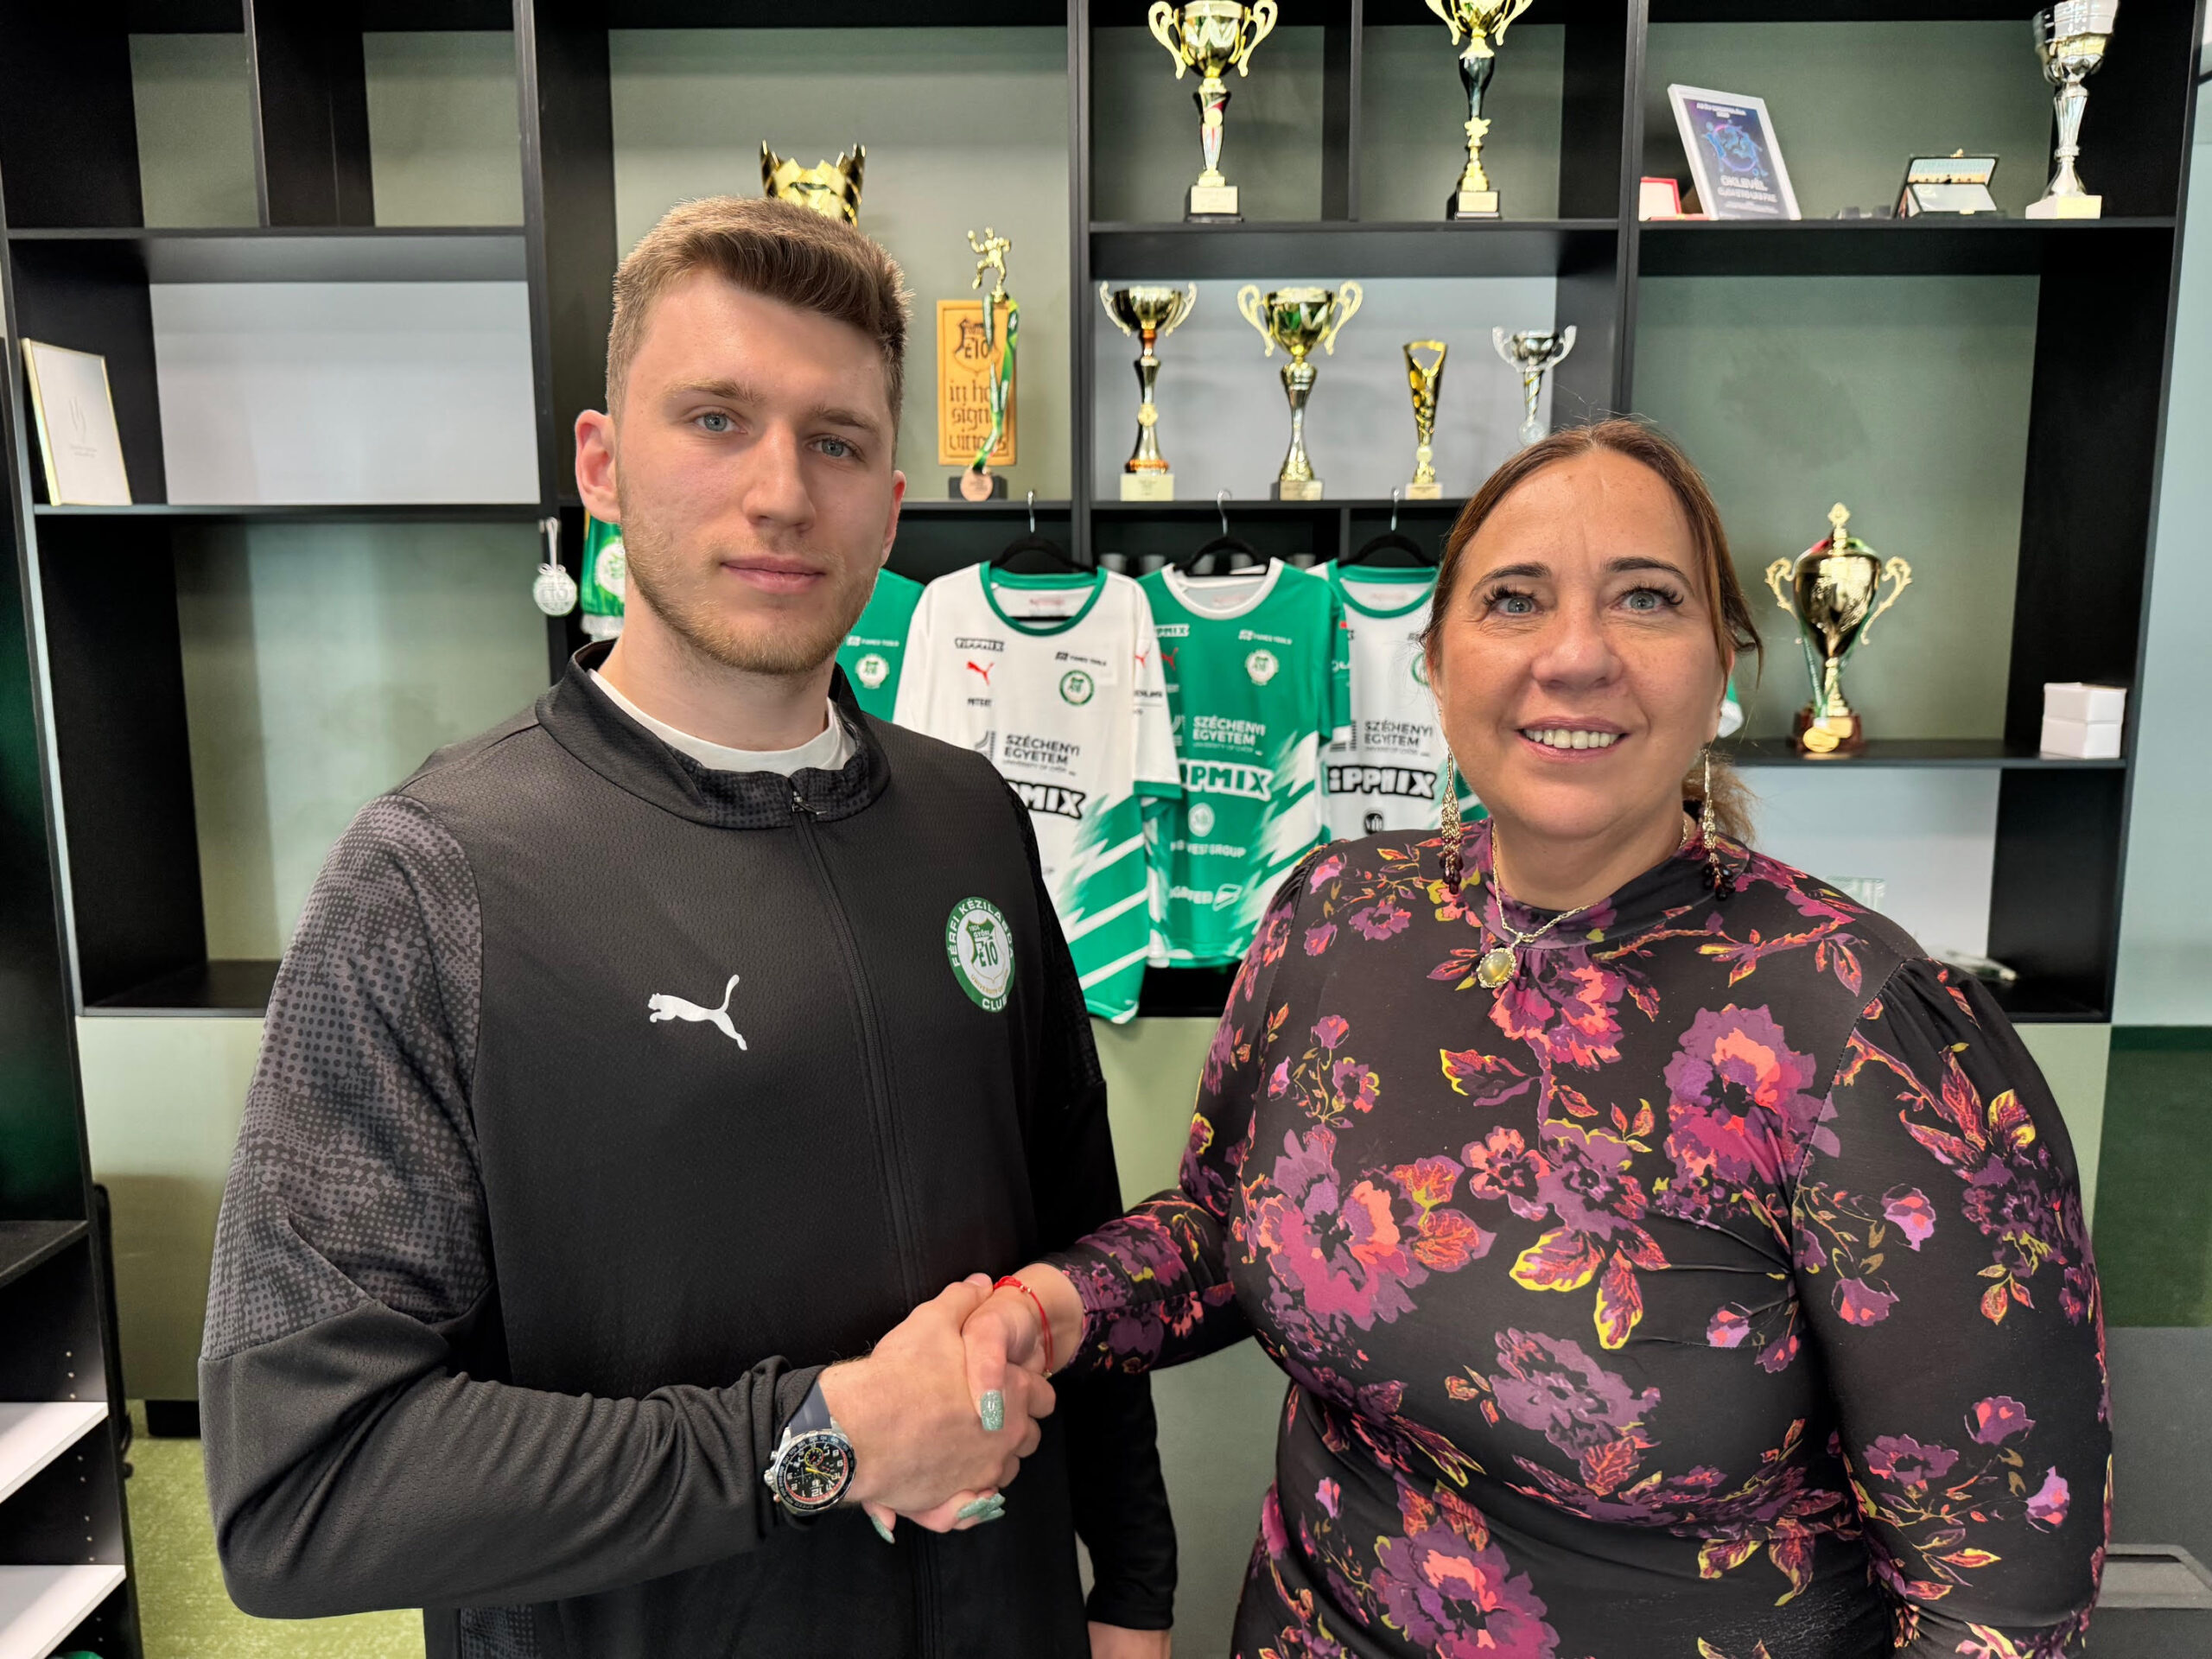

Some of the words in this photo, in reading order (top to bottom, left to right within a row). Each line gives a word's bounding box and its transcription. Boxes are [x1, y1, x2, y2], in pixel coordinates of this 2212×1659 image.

[1193, 715, 1266, 736] SZÉCHENYI
[1006, 734, 1080, 757] SZÉCHENYI
[1192, 728, 1255, 746] EGYETEM
[1004, 747, 1068, 765] EGYETEM
[1180, 759, 1274, 801] PMIX
[1005, 779, 1086, 820] MIX
[949, 915, 961, 967] FÉRFI
[811, 1487, 823, 1497] 12
